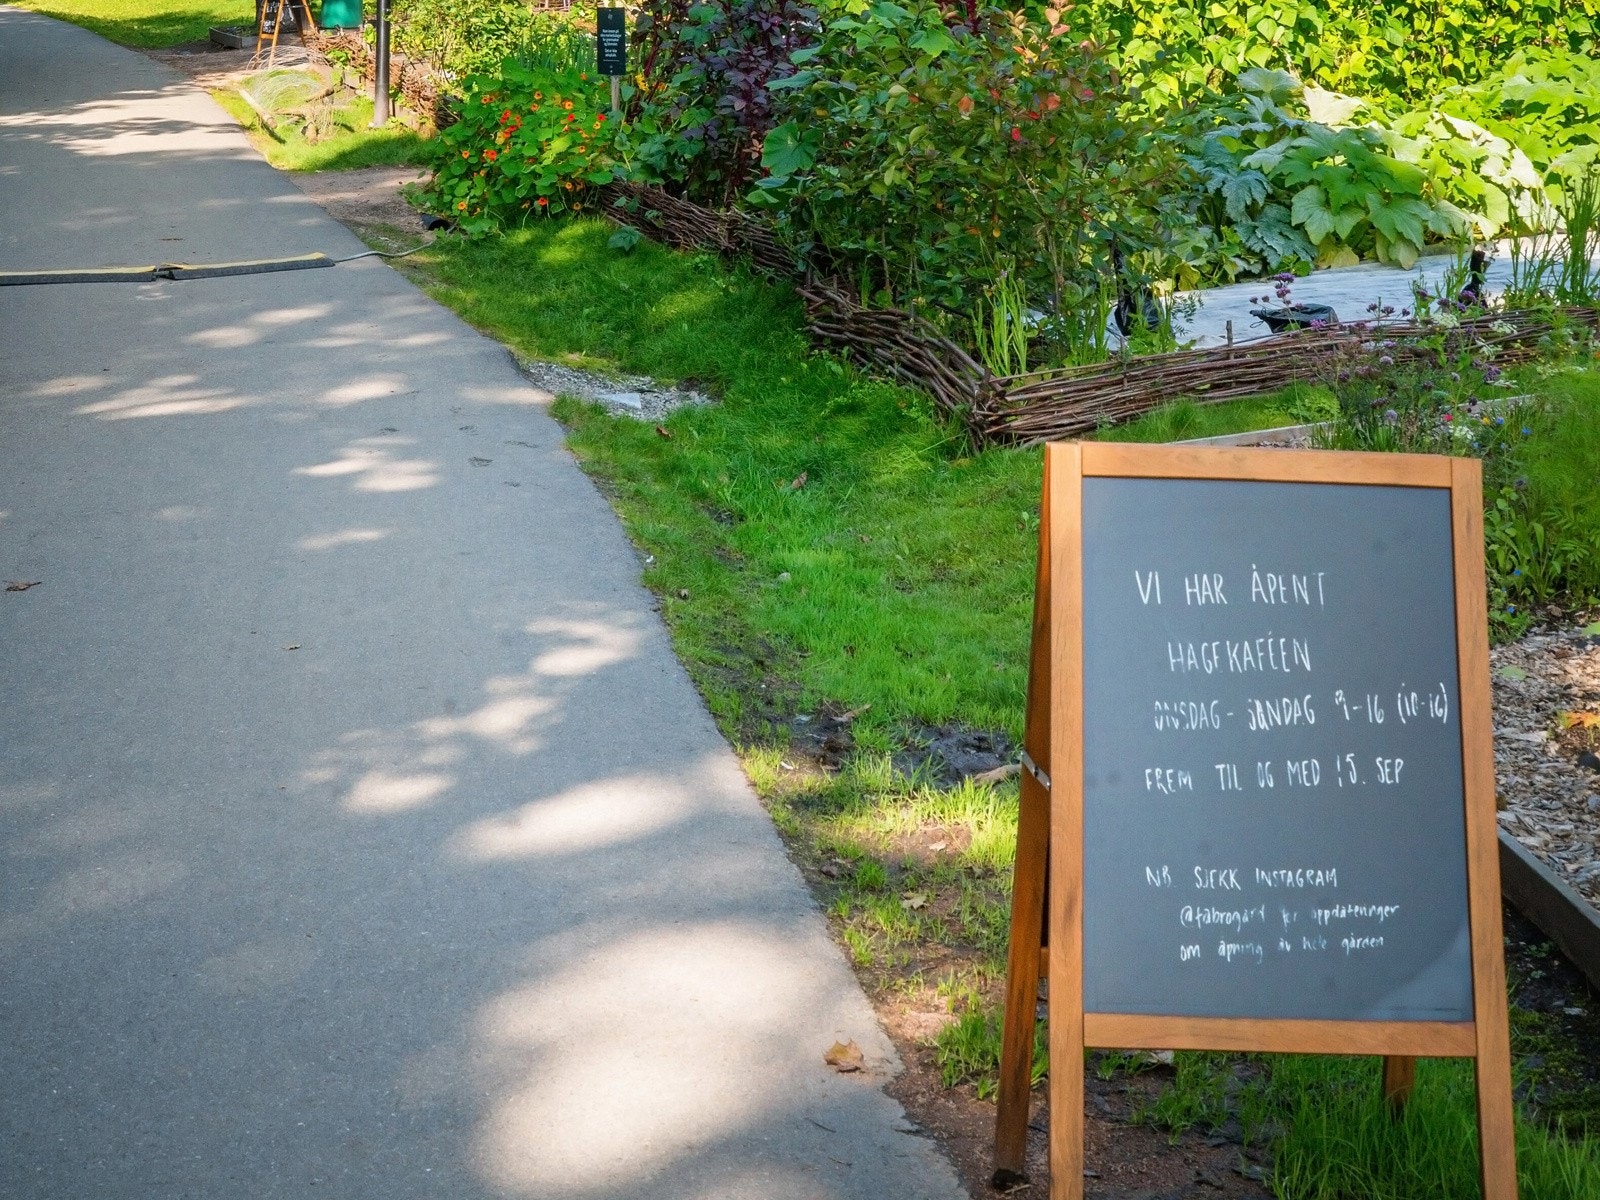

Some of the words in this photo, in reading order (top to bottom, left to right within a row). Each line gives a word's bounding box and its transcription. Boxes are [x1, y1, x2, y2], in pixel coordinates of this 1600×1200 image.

[1135, 570, 1161, 604] VI
[1185, 573, 1227, 605] HAR
[1252, 563, 1325, 610] ÅPENT
[1145, 767, 1193, 794] FREM
[1215, 763, 1242, 791] TIL
[1257, 761, 1274, 788] OG
[1287, 759, 1320, 786] MED
[1376, 757, 1404, 784] SEP
[1194, 866, 1241, 891] SJEKK
[1255, 867, 1338, 888] INSTAGRAM
[1180, 943, 1200, 961] om
[1341, 933, 1384, 955] gården
